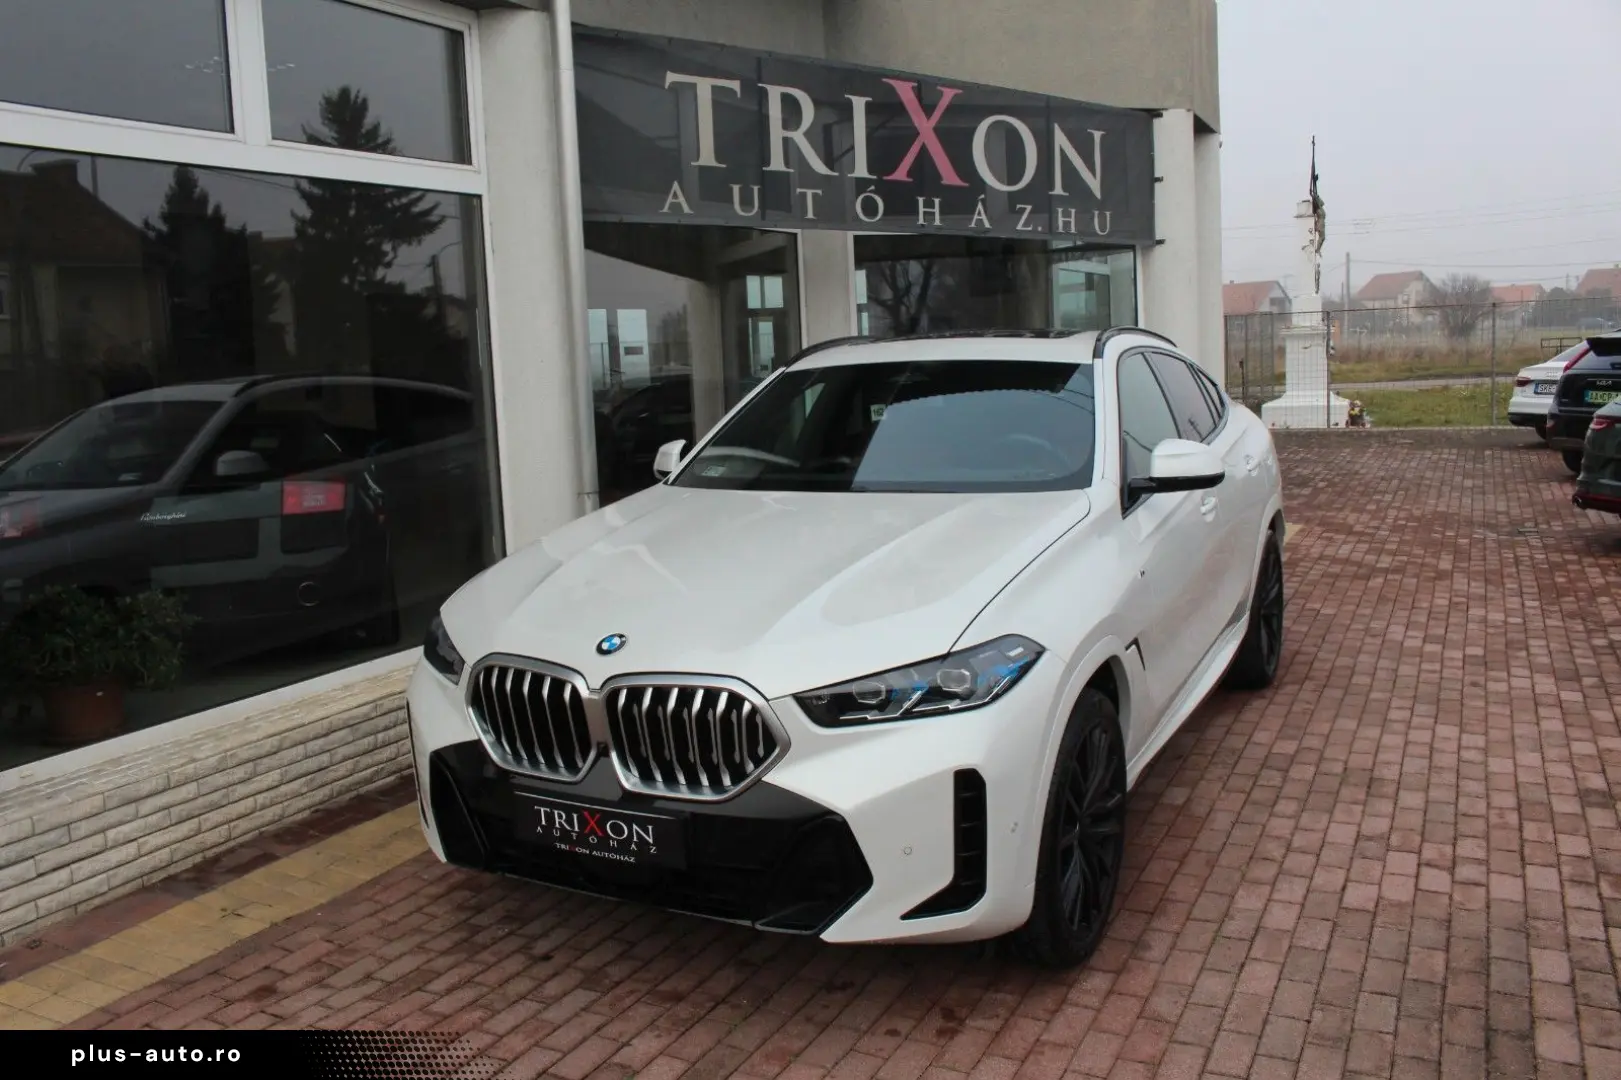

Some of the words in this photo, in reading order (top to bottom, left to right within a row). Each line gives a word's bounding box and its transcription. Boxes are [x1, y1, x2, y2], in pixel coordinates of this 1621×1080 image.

[664, 70, 1106, 200] TRIXON
[534, 805, 655, 845] TRIXON
[555, 842, 590, 854] TRIXON
